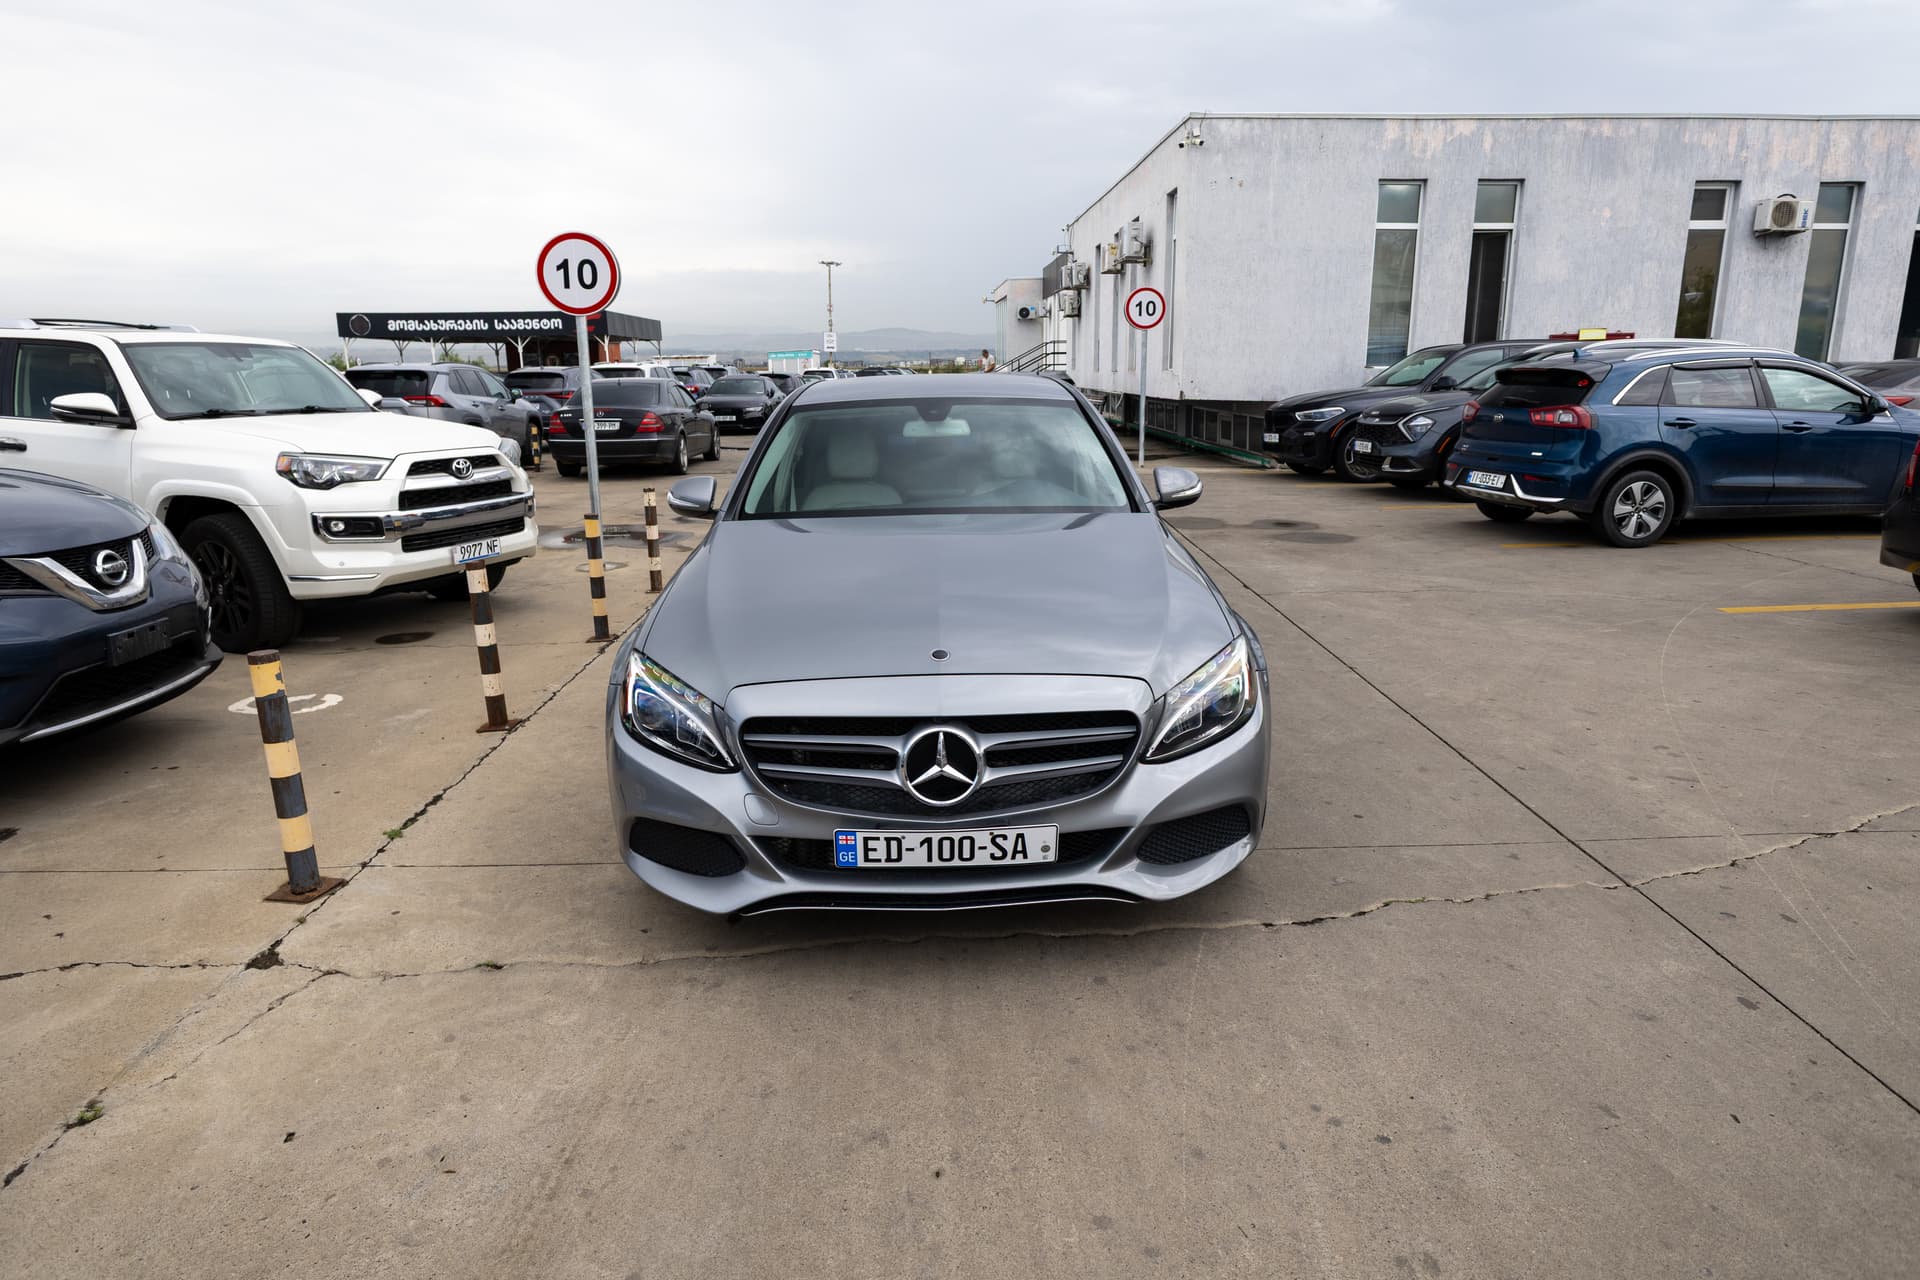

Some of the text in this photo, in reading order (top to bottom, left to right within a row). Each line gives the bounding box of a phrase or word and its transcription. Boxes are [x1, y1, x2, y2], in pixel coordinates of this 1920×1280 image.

[556, 258, 598, 290] 10
[1135, 300, 1157, 317] 10
[460, 542, 483, 559] 9977
[863, 832, 1029, 863] ED-100-SA
[839, 852, 856, 862] GE
